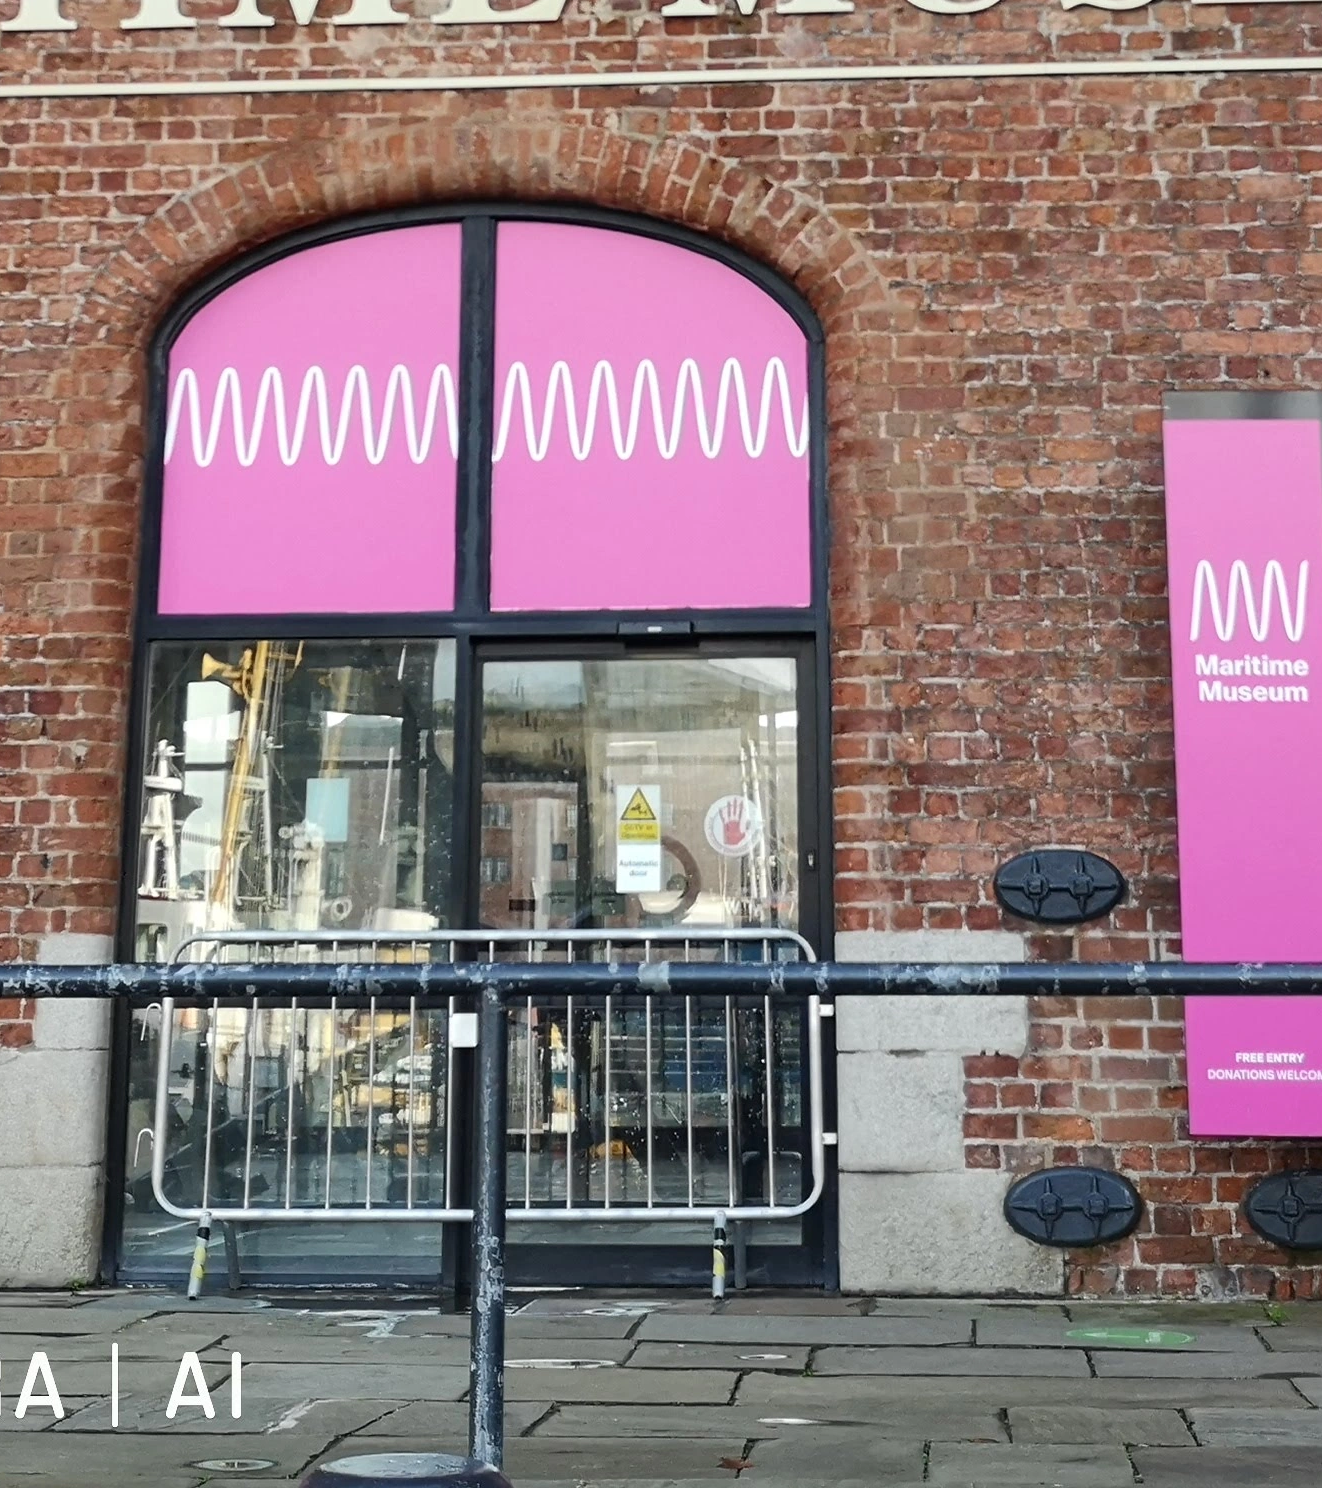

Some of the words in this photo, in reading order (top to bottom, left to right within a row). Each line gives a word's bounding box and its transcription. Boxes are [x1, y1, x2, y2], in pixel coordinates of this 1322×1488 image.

[1196, 654, 1309, 676] Maritime
[1199, 681, 1308, 701] Museum
[1236, 1053, 1264, 1063] FREE
[1266, 1053, 1304, 1063] ENTRY
[1208, 1069, 1275, 1080] DONATIONS
